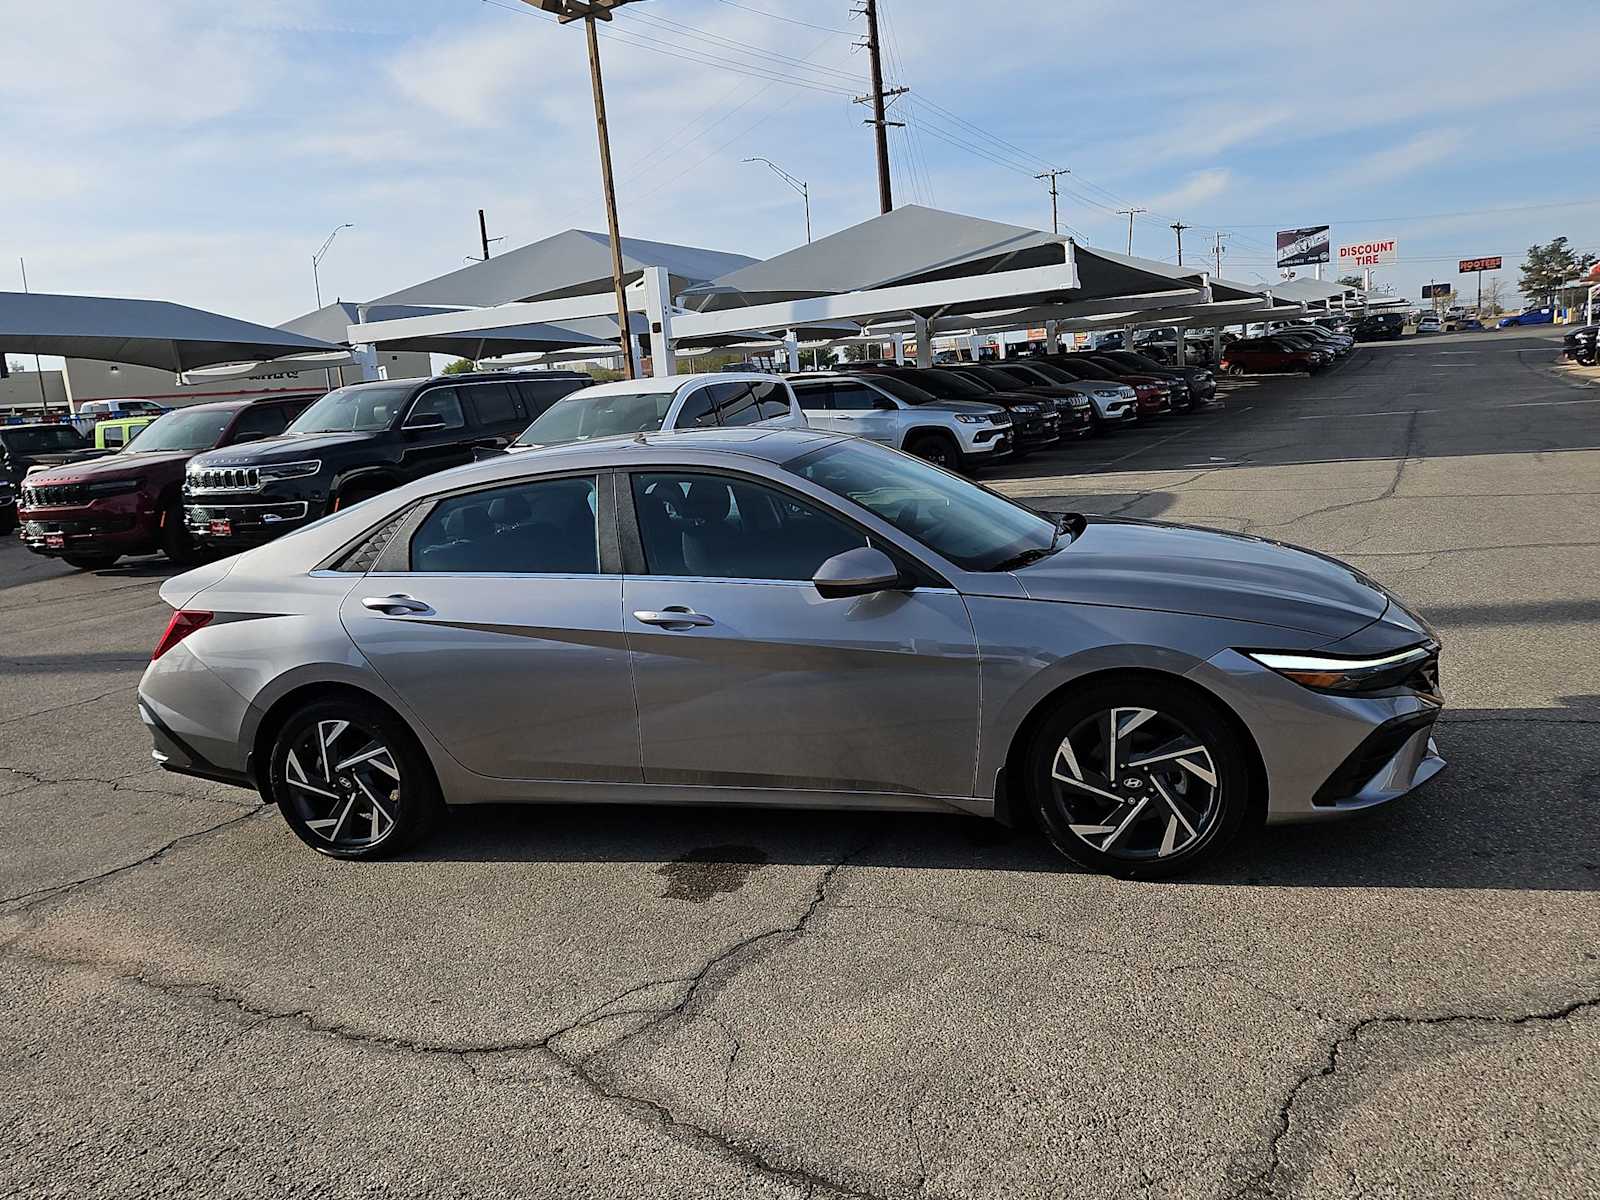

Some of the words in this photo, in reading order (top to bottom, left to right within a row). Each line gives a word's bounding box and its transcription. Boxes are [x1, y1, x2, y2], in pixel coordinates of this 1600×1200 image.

[1340, 241, 1394, 257] DISCOUNT
[1355, 254, 1379, 266] TIRE
[1460, 258, 1501, 269] HOOTERS
